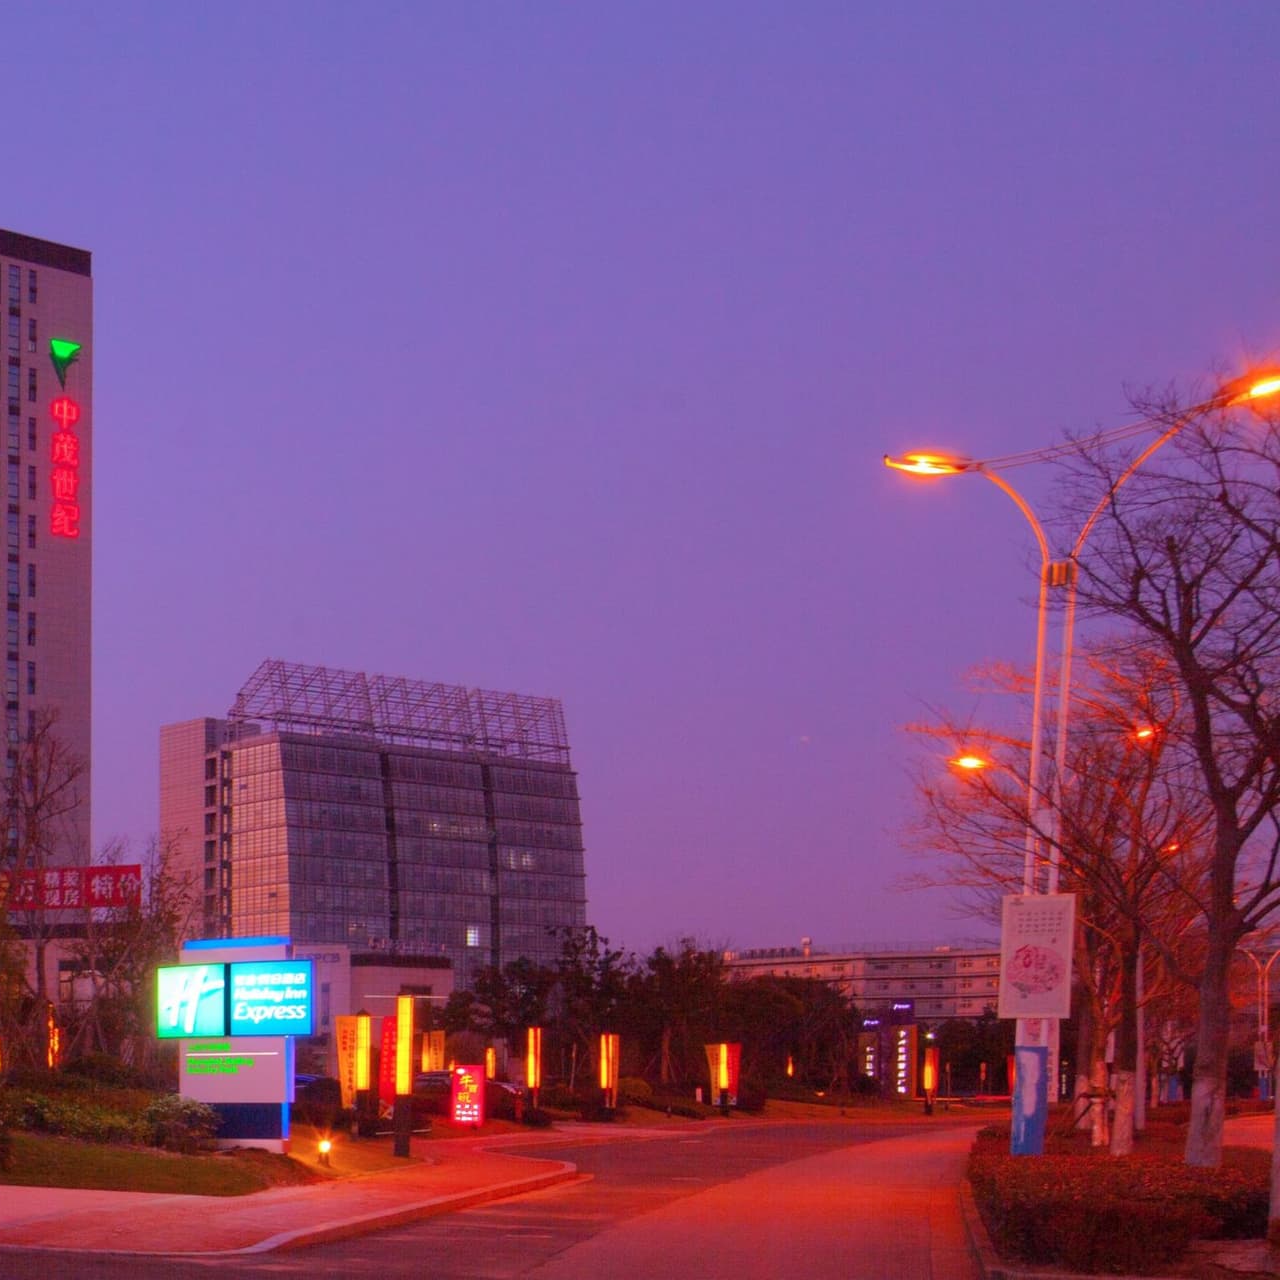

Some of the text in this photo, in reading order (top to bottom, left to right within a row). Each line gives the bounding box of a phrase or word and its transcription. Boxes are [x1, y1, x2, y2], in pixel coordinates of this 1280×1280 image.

[52, 398, 80, 538] 中茂世纪
[234, 986, 307, 1003] Holiday Inn
[233, 1002, 307, 1024] Express
